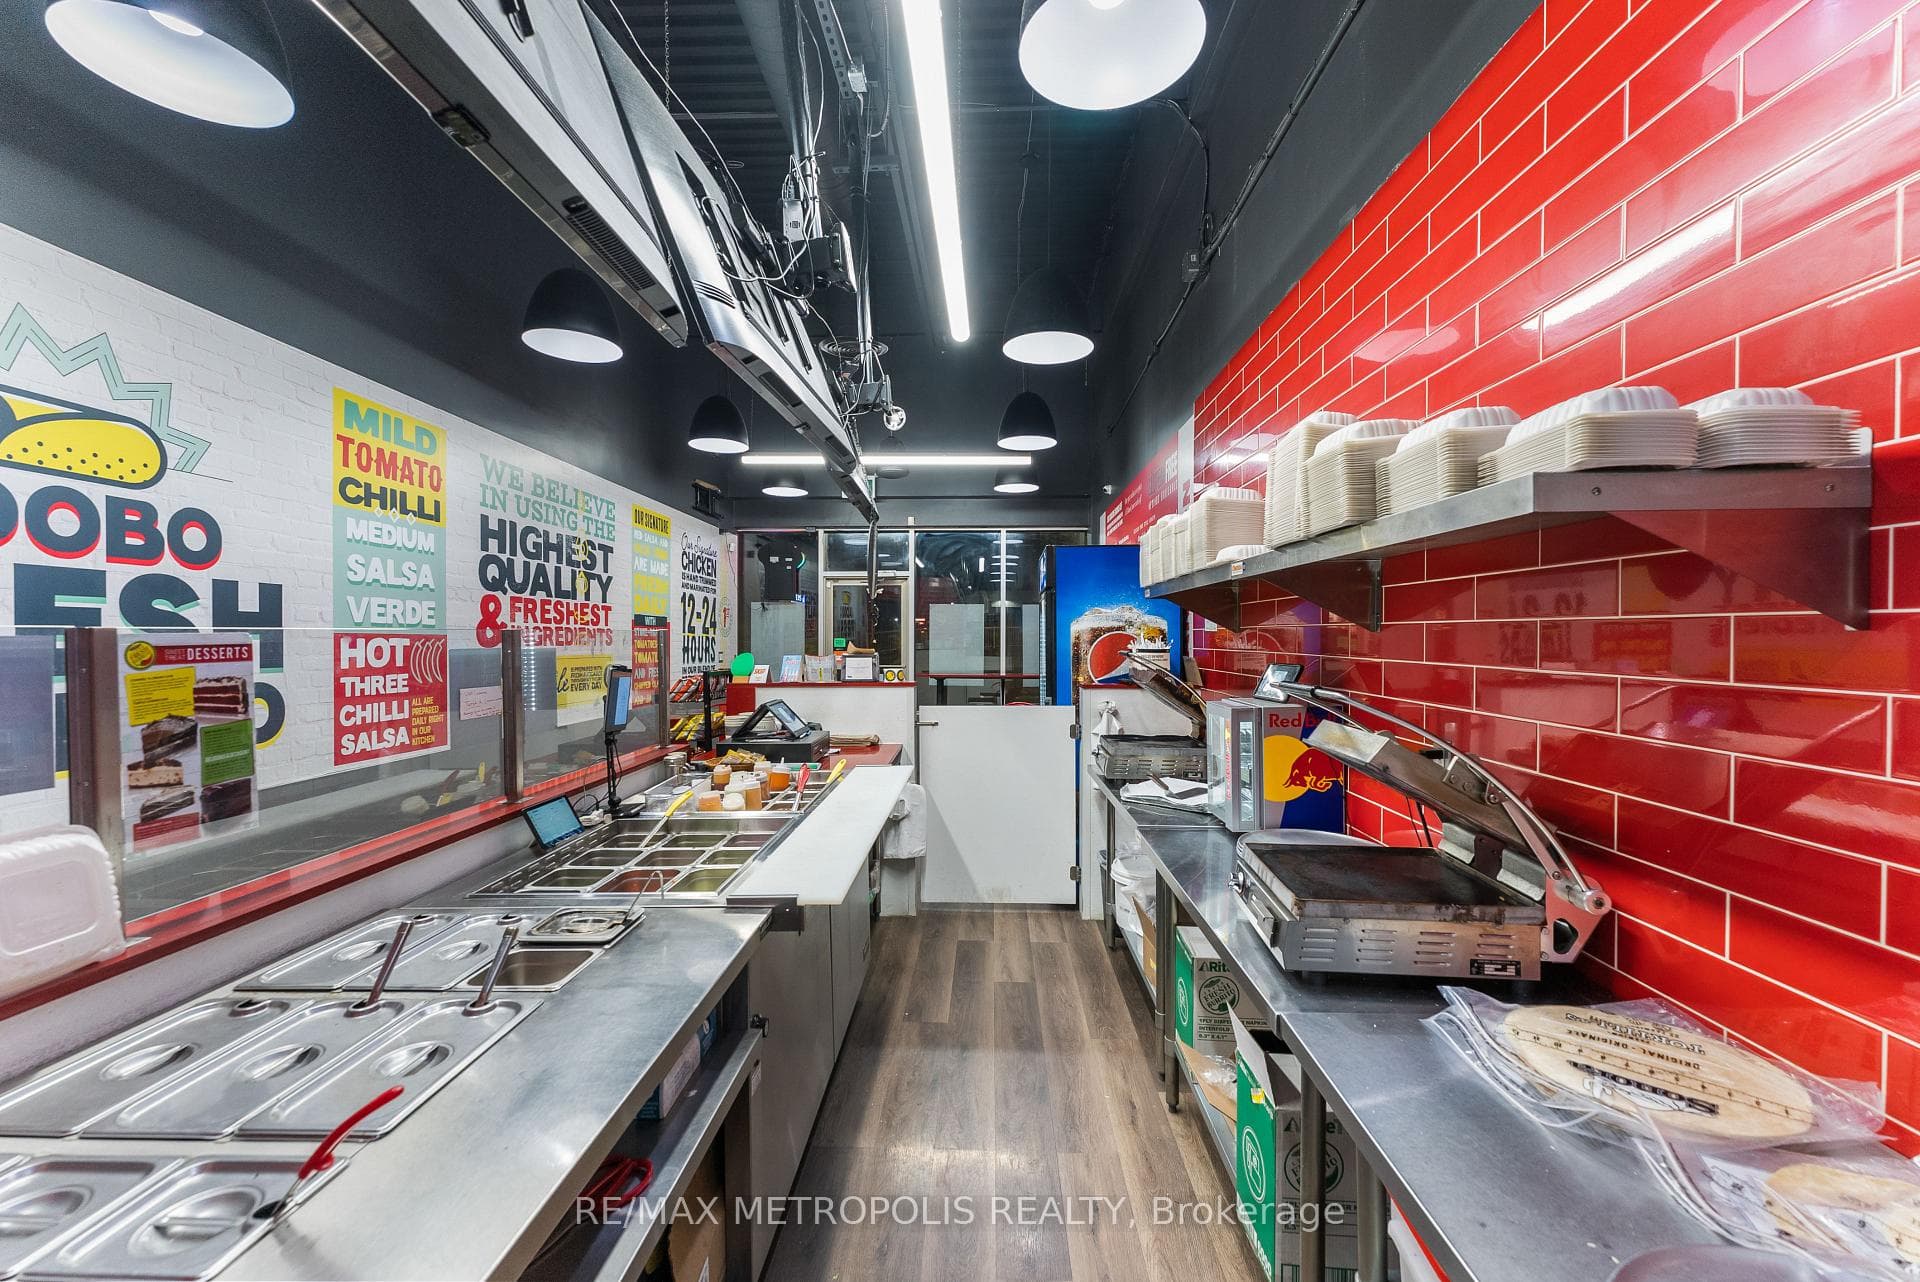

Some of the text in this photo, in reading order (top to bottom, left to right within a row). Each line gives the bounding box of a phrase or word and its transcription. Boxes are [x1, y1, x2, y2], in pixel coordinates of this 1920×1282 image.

[344, 399, 437, 455] MILD
[337, 434, 443, 492] TOMATO
[339, 477, 440, 522] CHILLI
[480, 453, 616, 522] WE BELIEVE
[480, 483, 616, 541] IN USING THE
[634, 509, 669, 534] OUR SIGNATURE
[346, 517, 435, 555] MEDIUM
[480, 514, 614, 573] HIGHEST
[346, 554, 435, 592] SALSA
[650, 560, 669, 576] MADE
[682, 551, 717, 578] CHICKEN
[479, 554, 613, 603] QUALITY
[346, 596, 436, 627] VERDE
[476, 594, 612, 648] & FRESHEST
[645, 617, 656, 625] WITH
[681, 592, 717, 635] 12-24
[187, 646, 248, 661] DESSERTS
[340, 637, 410, 669] HOT
[682, 636, 716, 664] HOURS
[340, 674, 408, 697] THREE
[571, 681, 602, 692] EVERY DAY
[339, 700, 409, 727] CHILLI
[412, 696, 434, 706] ALL ARE
[412, 706, 439, 715] PREPARED
[412, 714, 444, 725] DAILY RIGHT
[419, 726, 431, 734] OUR
[1269, 712, 1302, 727] Red
[340, 726, 410, 756] SALSA
[1203, 983, 1231, 1002] FRESH
[1207, 988, 1236, 1009] BURRITO
[1642, 1048, 1700, 1070] ORIGINAL
